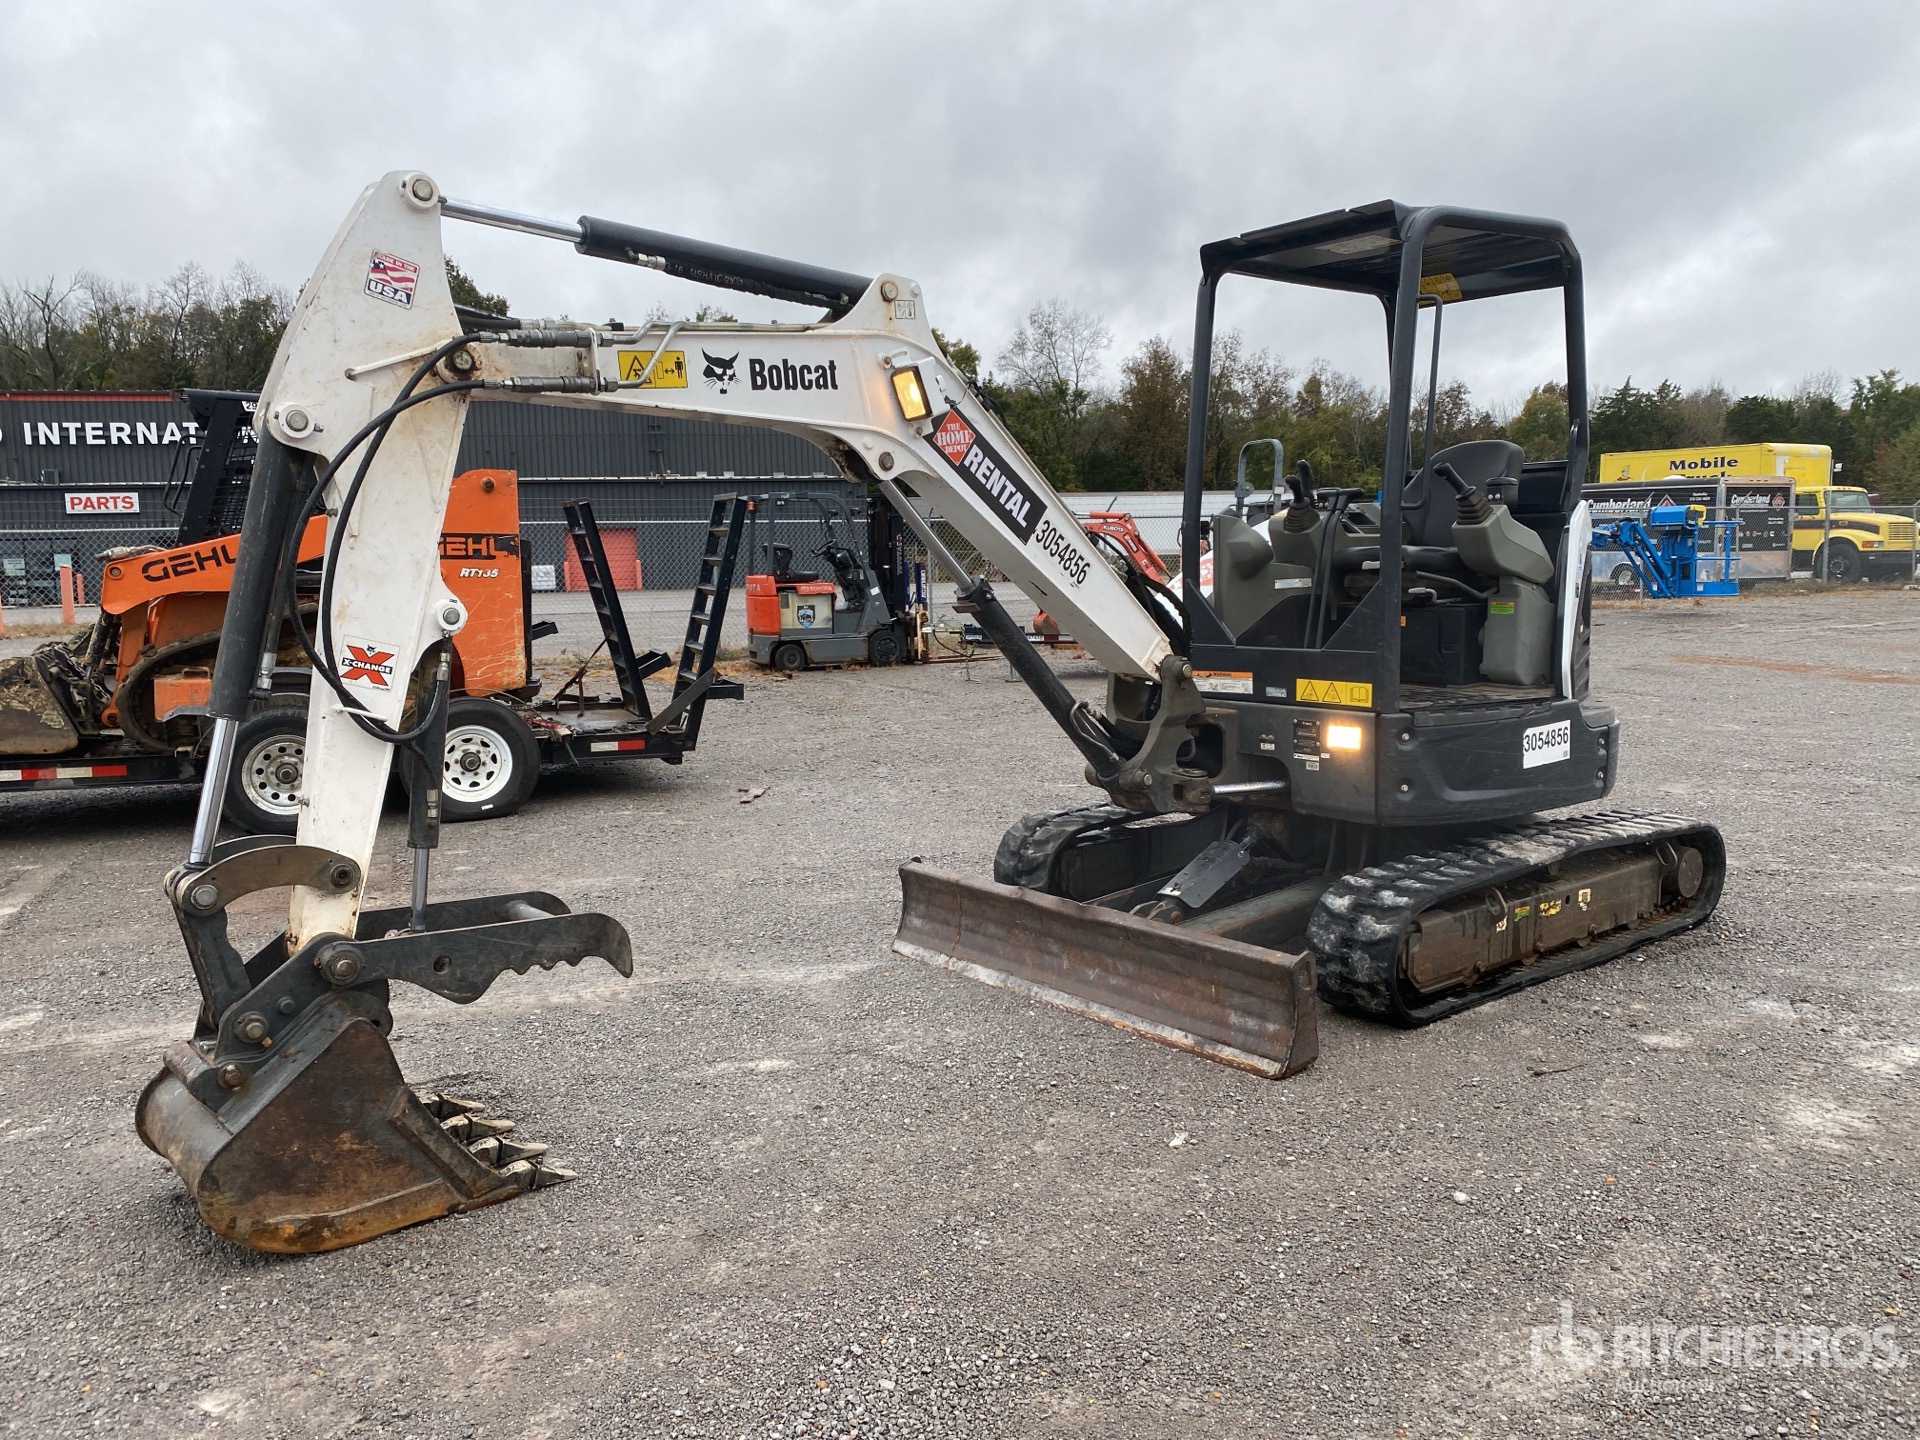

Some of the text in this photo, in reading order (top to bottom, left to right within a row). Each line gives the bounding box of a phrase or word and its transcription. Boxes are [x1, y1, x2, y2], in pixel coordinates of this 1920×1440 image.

[370, 280, 408, 303] USA
[749, 359, 838, 391] Bobcat
[947, 423, 961, 431] THE
[937, 430, 972, 446] HOME
[945, 444, 968, 454] DEPOT
[1669, 456, 1738, 470] Mobile
[964, 444, 1031, 528] RENTAL
[69, 496, 134, 510] PARTS
[1035, 519, 1091, 585] 3054856
[459, 567, 499, 578] RT135
[342, 658, 392, 674] X-CHANGE
[1524, 726, 1569, 752] 3054856
